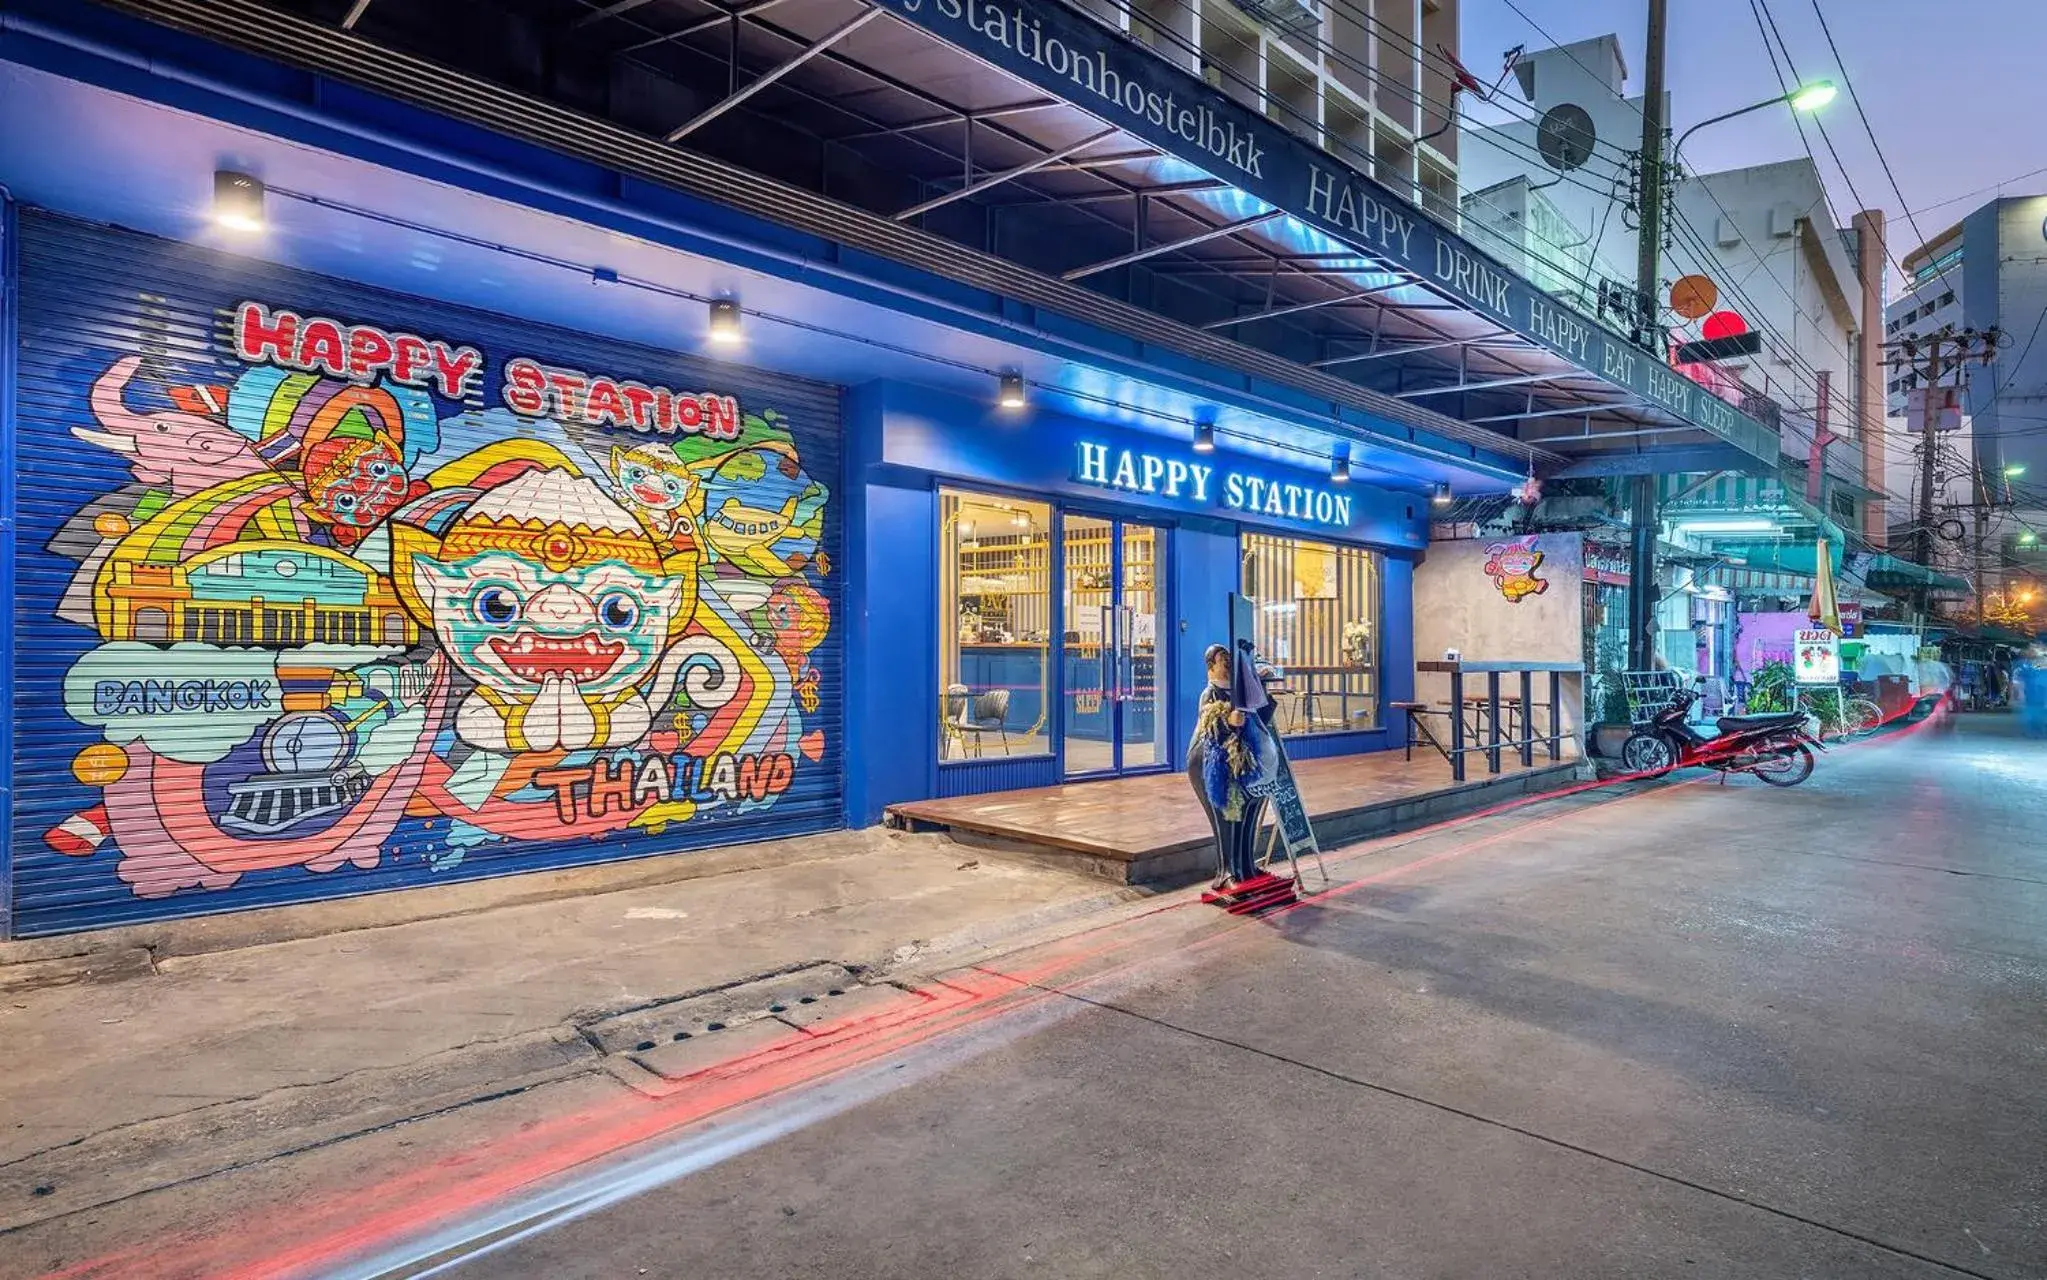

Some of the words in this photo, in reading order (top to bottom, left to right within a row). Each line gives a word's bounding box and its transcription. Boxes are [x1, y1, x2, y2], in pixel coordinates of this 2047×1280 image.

[904, 0, 1265, 181] stationhostelbkk
[1306, 164, 1415, 261] HAPPY
[1433, 237, 1511, 318] DRINK
[1529, 297, 1590, 360] HAPPY
[1603, 343, 1636, 387] EAT
[1648, 367, 1691, 414] HAPPY
[1700, 398, 1734, 434] SLEEP
[235, 302, 483, 399] HAPPY
[503, 358, 740, 440] STATION
[1078, 440, 1214, 502] HAPPY
[1225, 472, 1353, 527] STATION
[94, 679, 272, 716] BANGKOK
[531, 752, 796, 825] THAILAND
